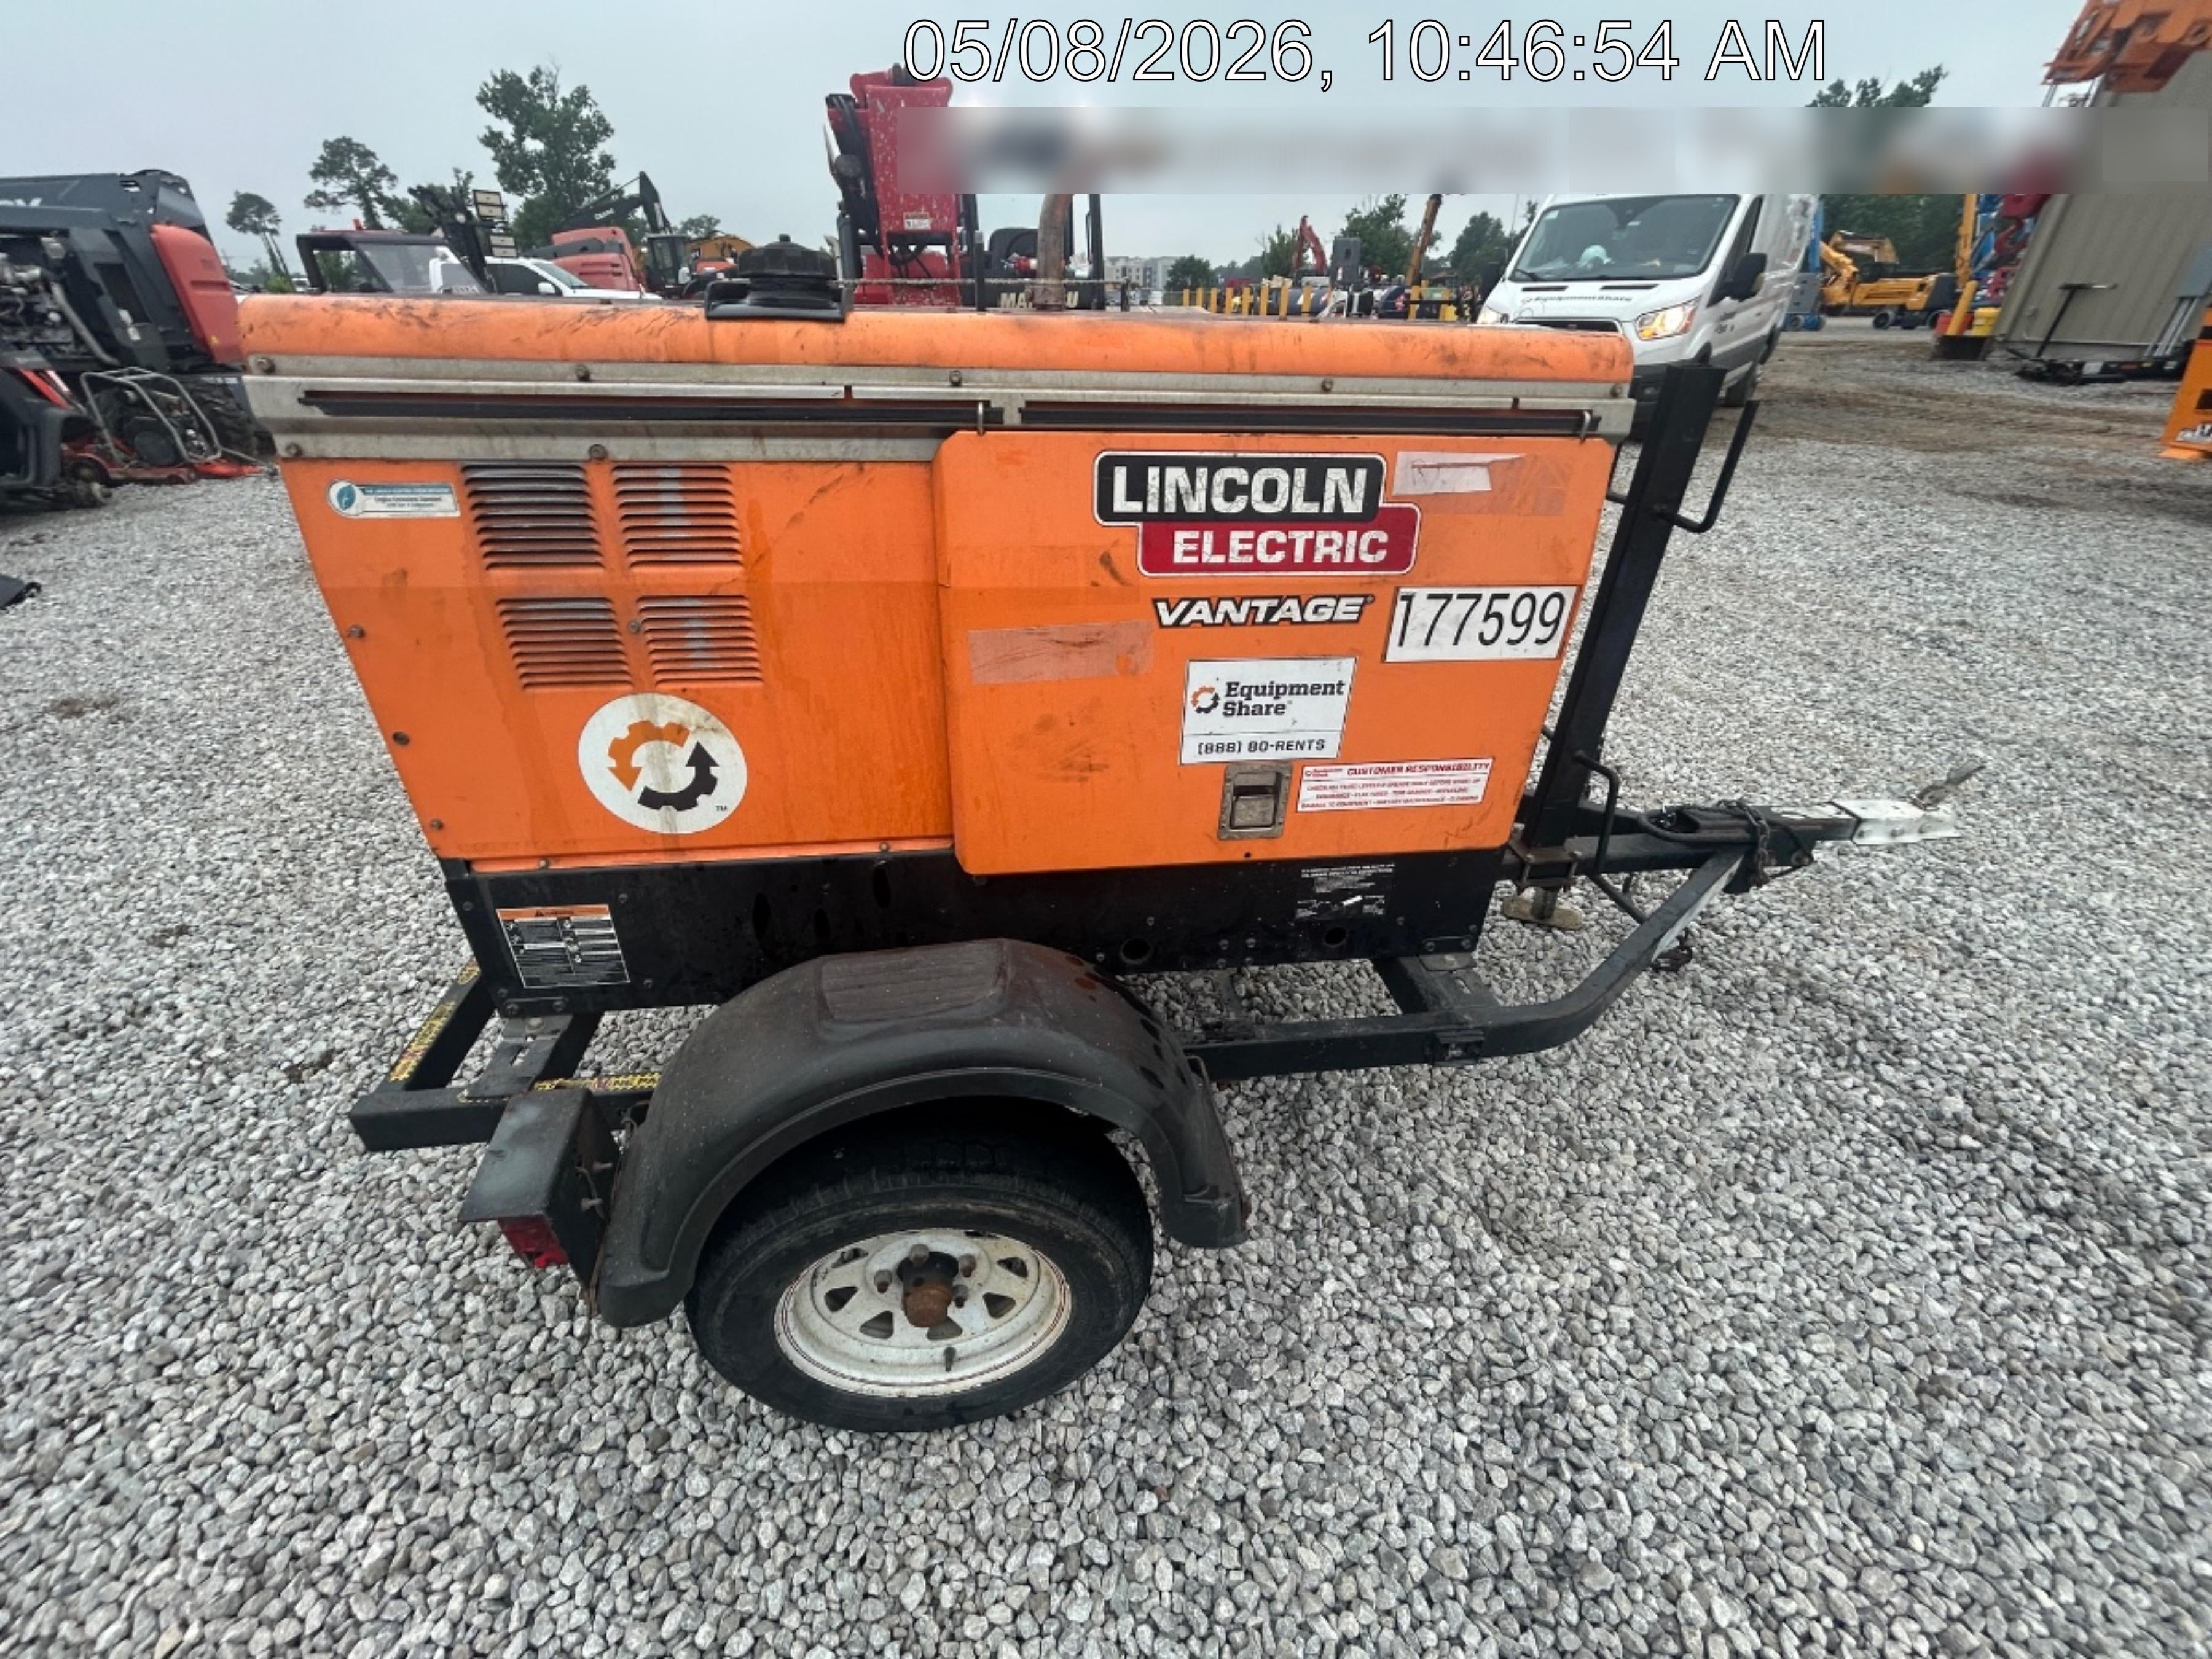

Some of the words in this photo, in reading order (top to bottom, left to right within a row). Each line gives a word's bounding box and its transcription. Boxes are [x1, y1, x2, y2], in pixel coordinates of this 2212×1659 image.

[1113, 466, 1368, 514] LINCOLN
[1172, 530, 1389, 564] ELECTRIC
[1155, 596, 1366, 626] VANTAGE
[1397, 591, 1566, 647] 177599
[1224, 680, 1346, 701] Equipment
[1222, 702, 1287, 717] Share
[1198, 740, 1242, 755] (888)
[1347, 765, 1403, 776] CUSTOMER
